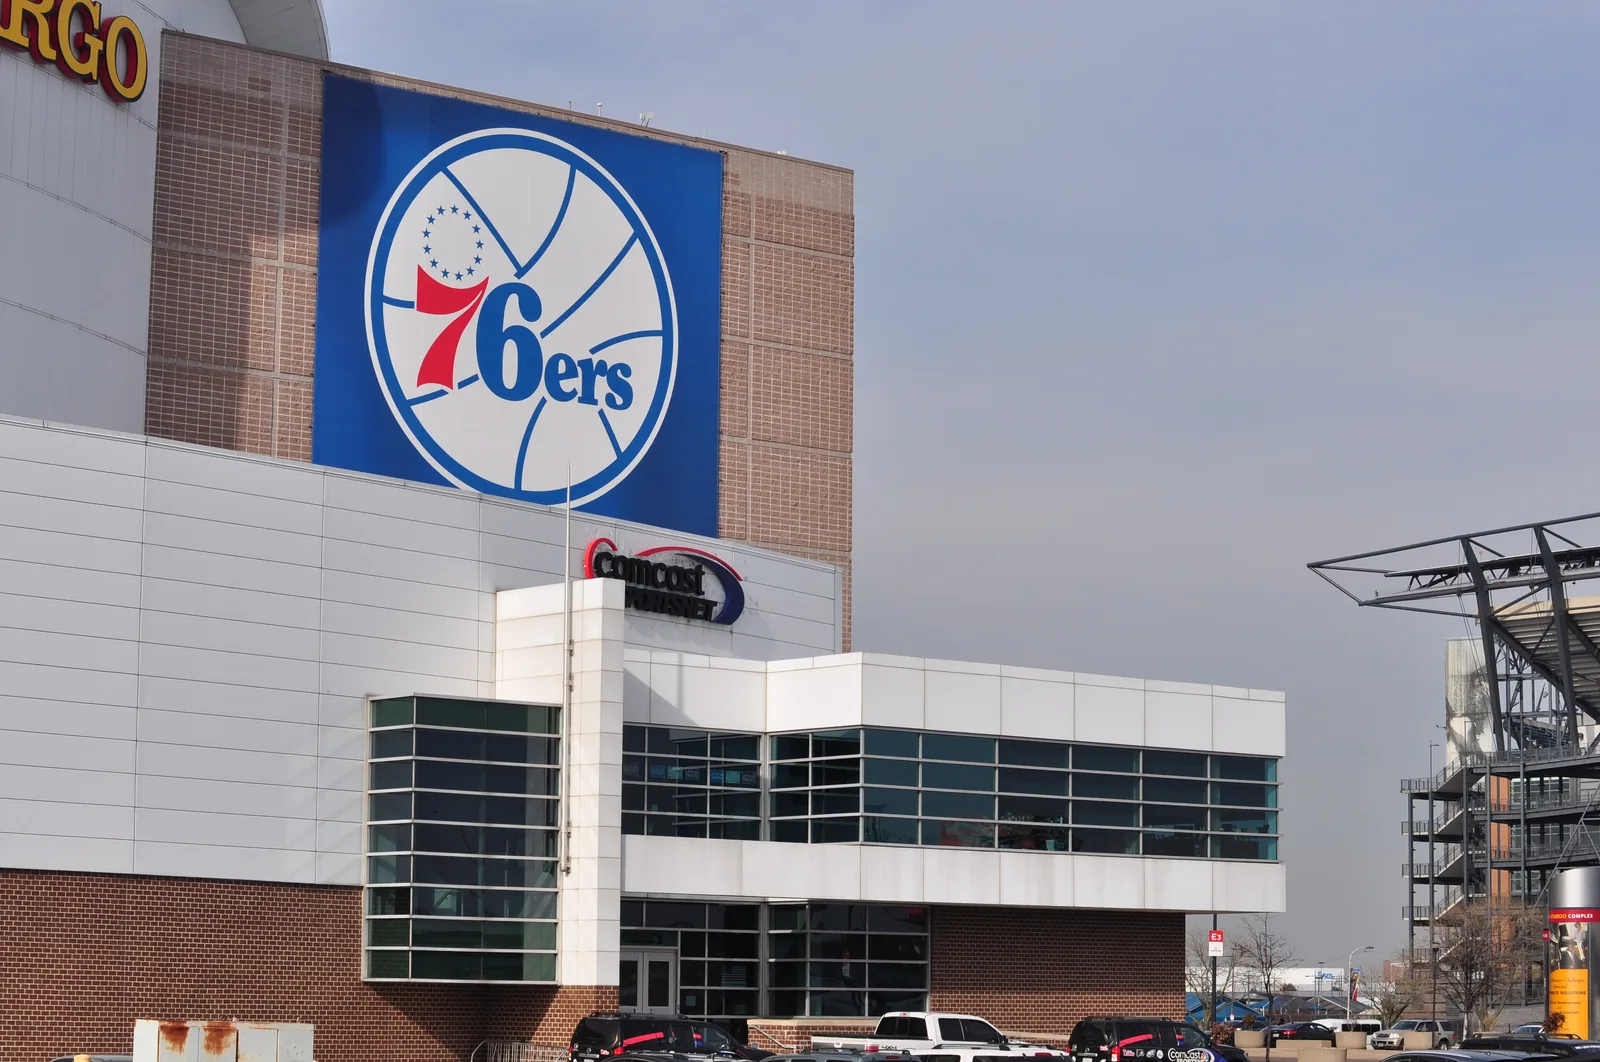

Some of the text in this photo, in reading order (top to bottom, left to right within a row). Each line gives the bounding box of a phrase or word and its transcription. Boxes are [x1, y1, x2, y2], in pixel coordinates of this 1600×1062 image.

[416, 264, 634, 411] 76ers
[625, 586, 719, 622] PORTSNET
[1211, 933, 1222, 941] E3
